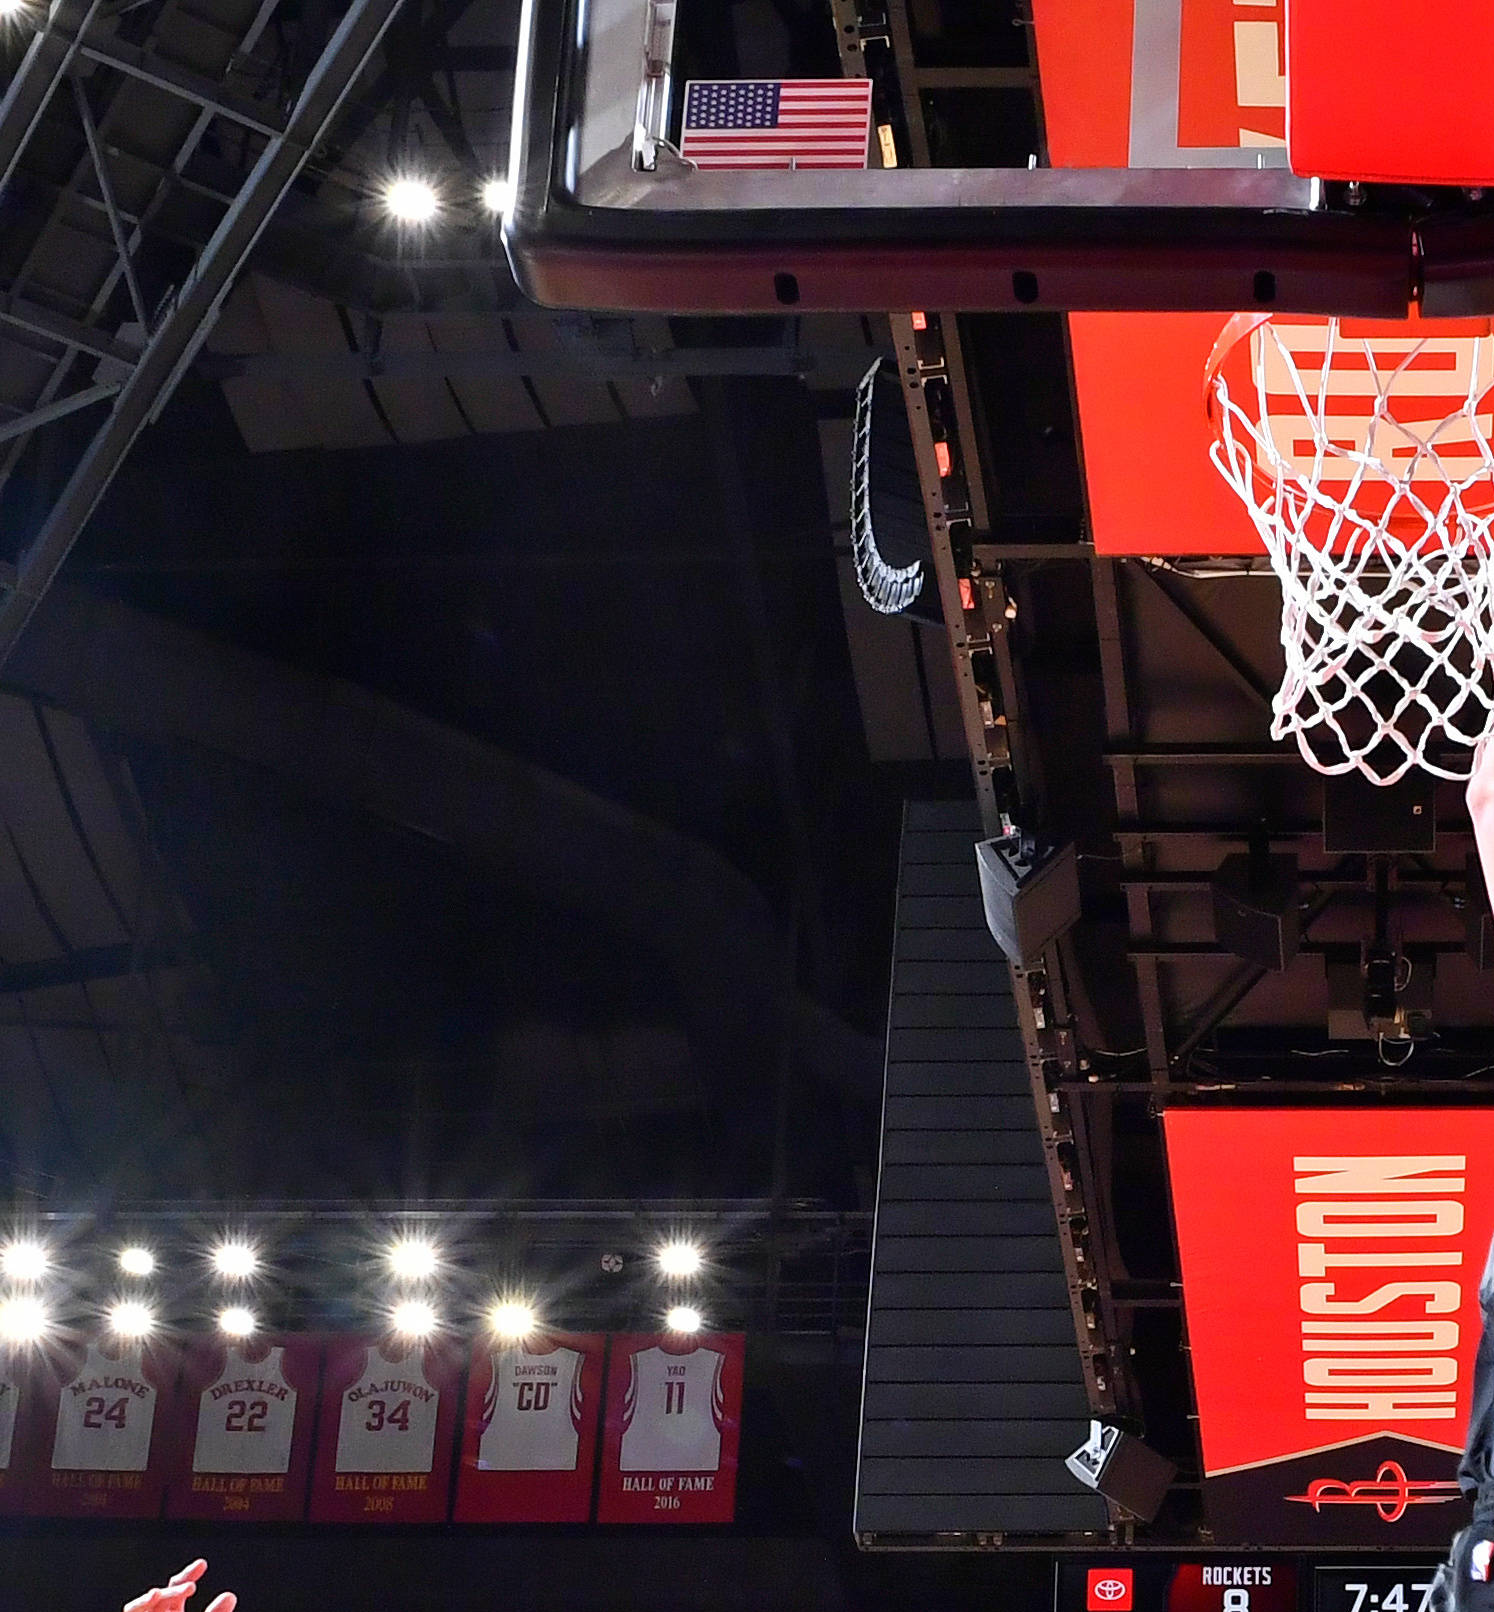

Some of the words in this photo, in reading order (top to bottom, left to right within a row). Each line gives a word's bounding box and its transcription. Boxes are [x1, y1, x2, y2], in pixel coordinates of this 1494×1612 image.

[1293, 1154, 1467, 1420] HOUSTON
[514, 1365, 558, 1377] DAWSON
[666, 1366, 687, 1377] YAO
[71, 1376, 150, 1399] MALONE
[211, 1380, 288, 1400] DREXLER
[348, 1380, 435, 1403] OLAJUWON
[665, 1382, 686, 1414] 11
[83, 1397, 129, 1429] 24
[225, 1400, 268, 1432] 22
[365, 1400, 412, 1432] 34
[335, 1475, 370, 1491] HALL
[391, 1475, 428, 1490] FAME
[622, 1476, 655, 1492] HALL
[658, 1476, 675, 1491] OF
[678, 1476, 715, 1491] FAME
[653, 1496, 681, 1510] 2016
[1202, 1566, 1272, 1586] ROCKETS
